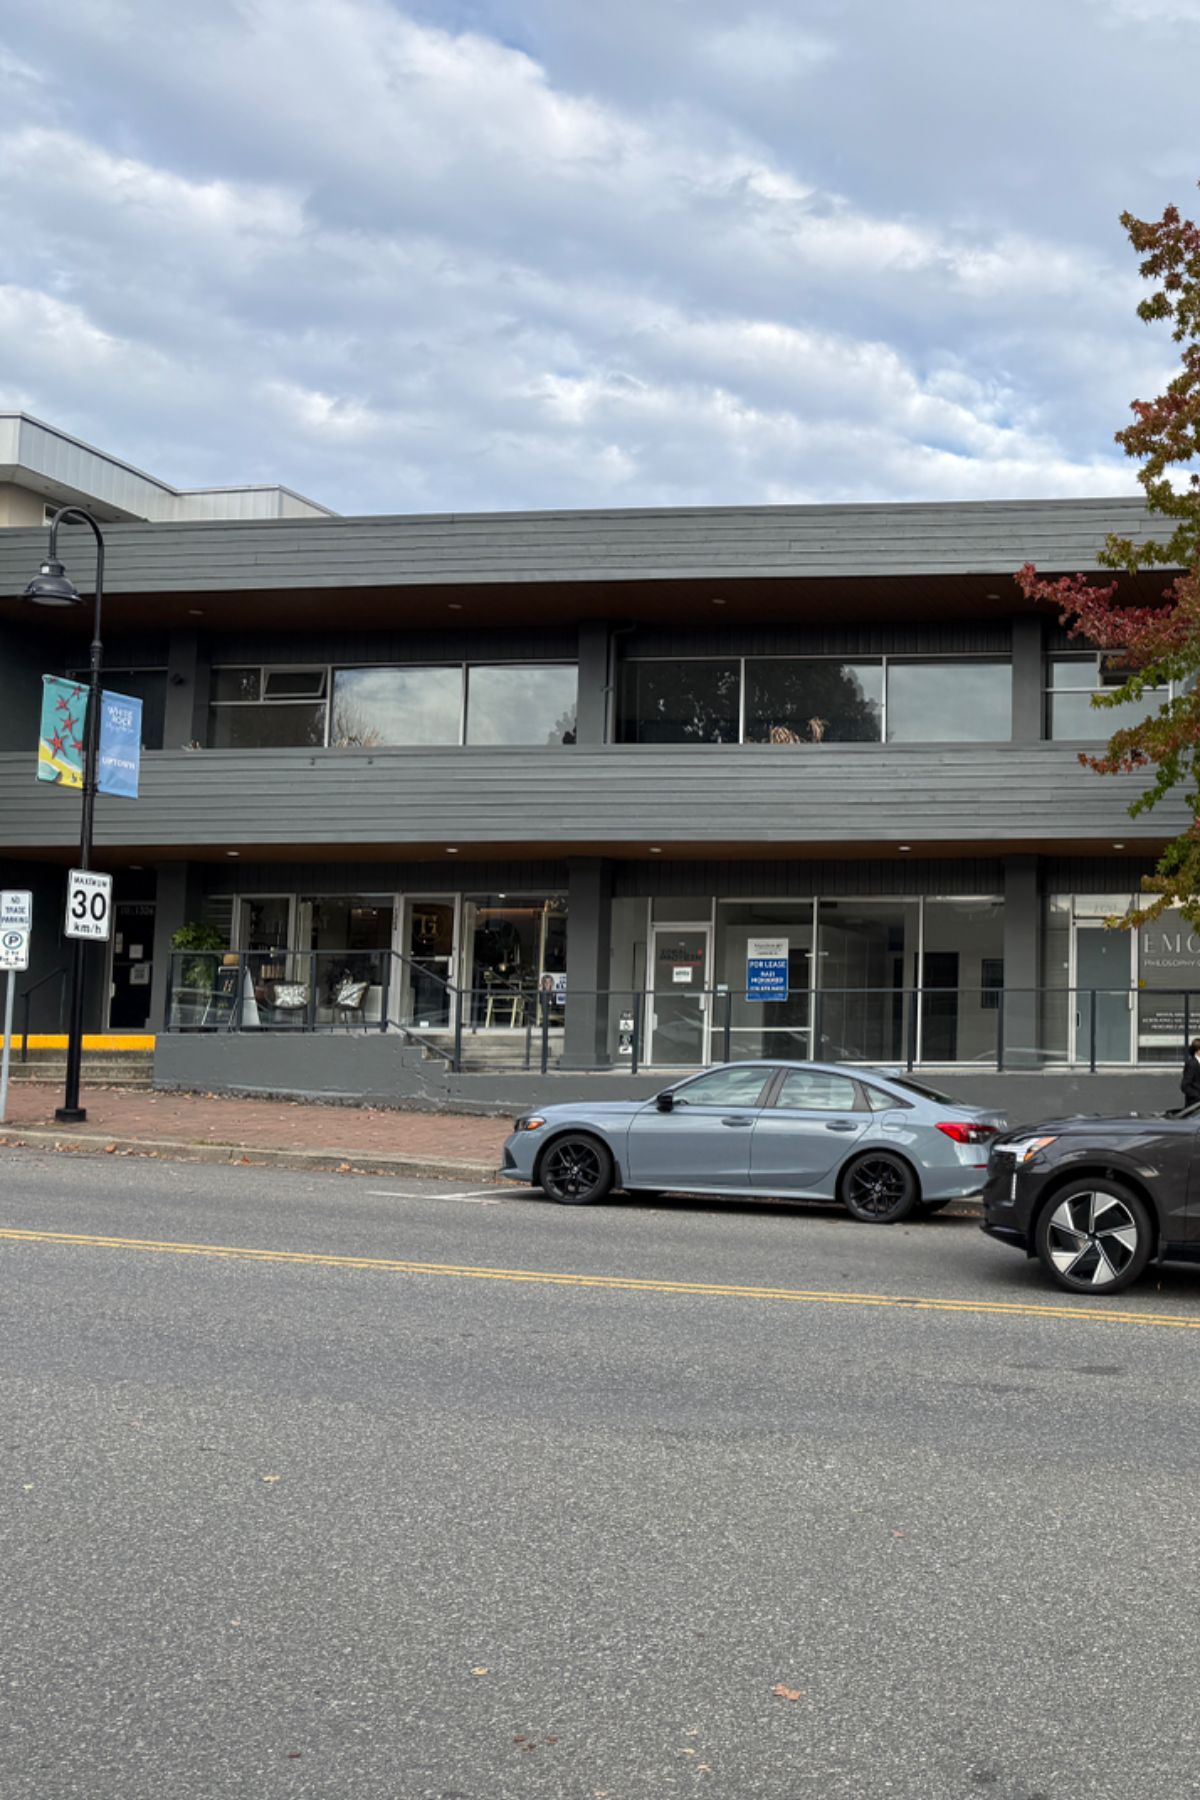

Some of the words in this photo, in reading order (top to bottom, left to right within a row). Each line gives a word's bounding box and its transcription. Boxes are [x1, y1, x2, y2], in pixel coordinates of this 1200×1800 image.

[102, 756, 136, 770] UPTOWN
[71, 889, 107, 921] 30
[74, 921, 102, 934] km/h
